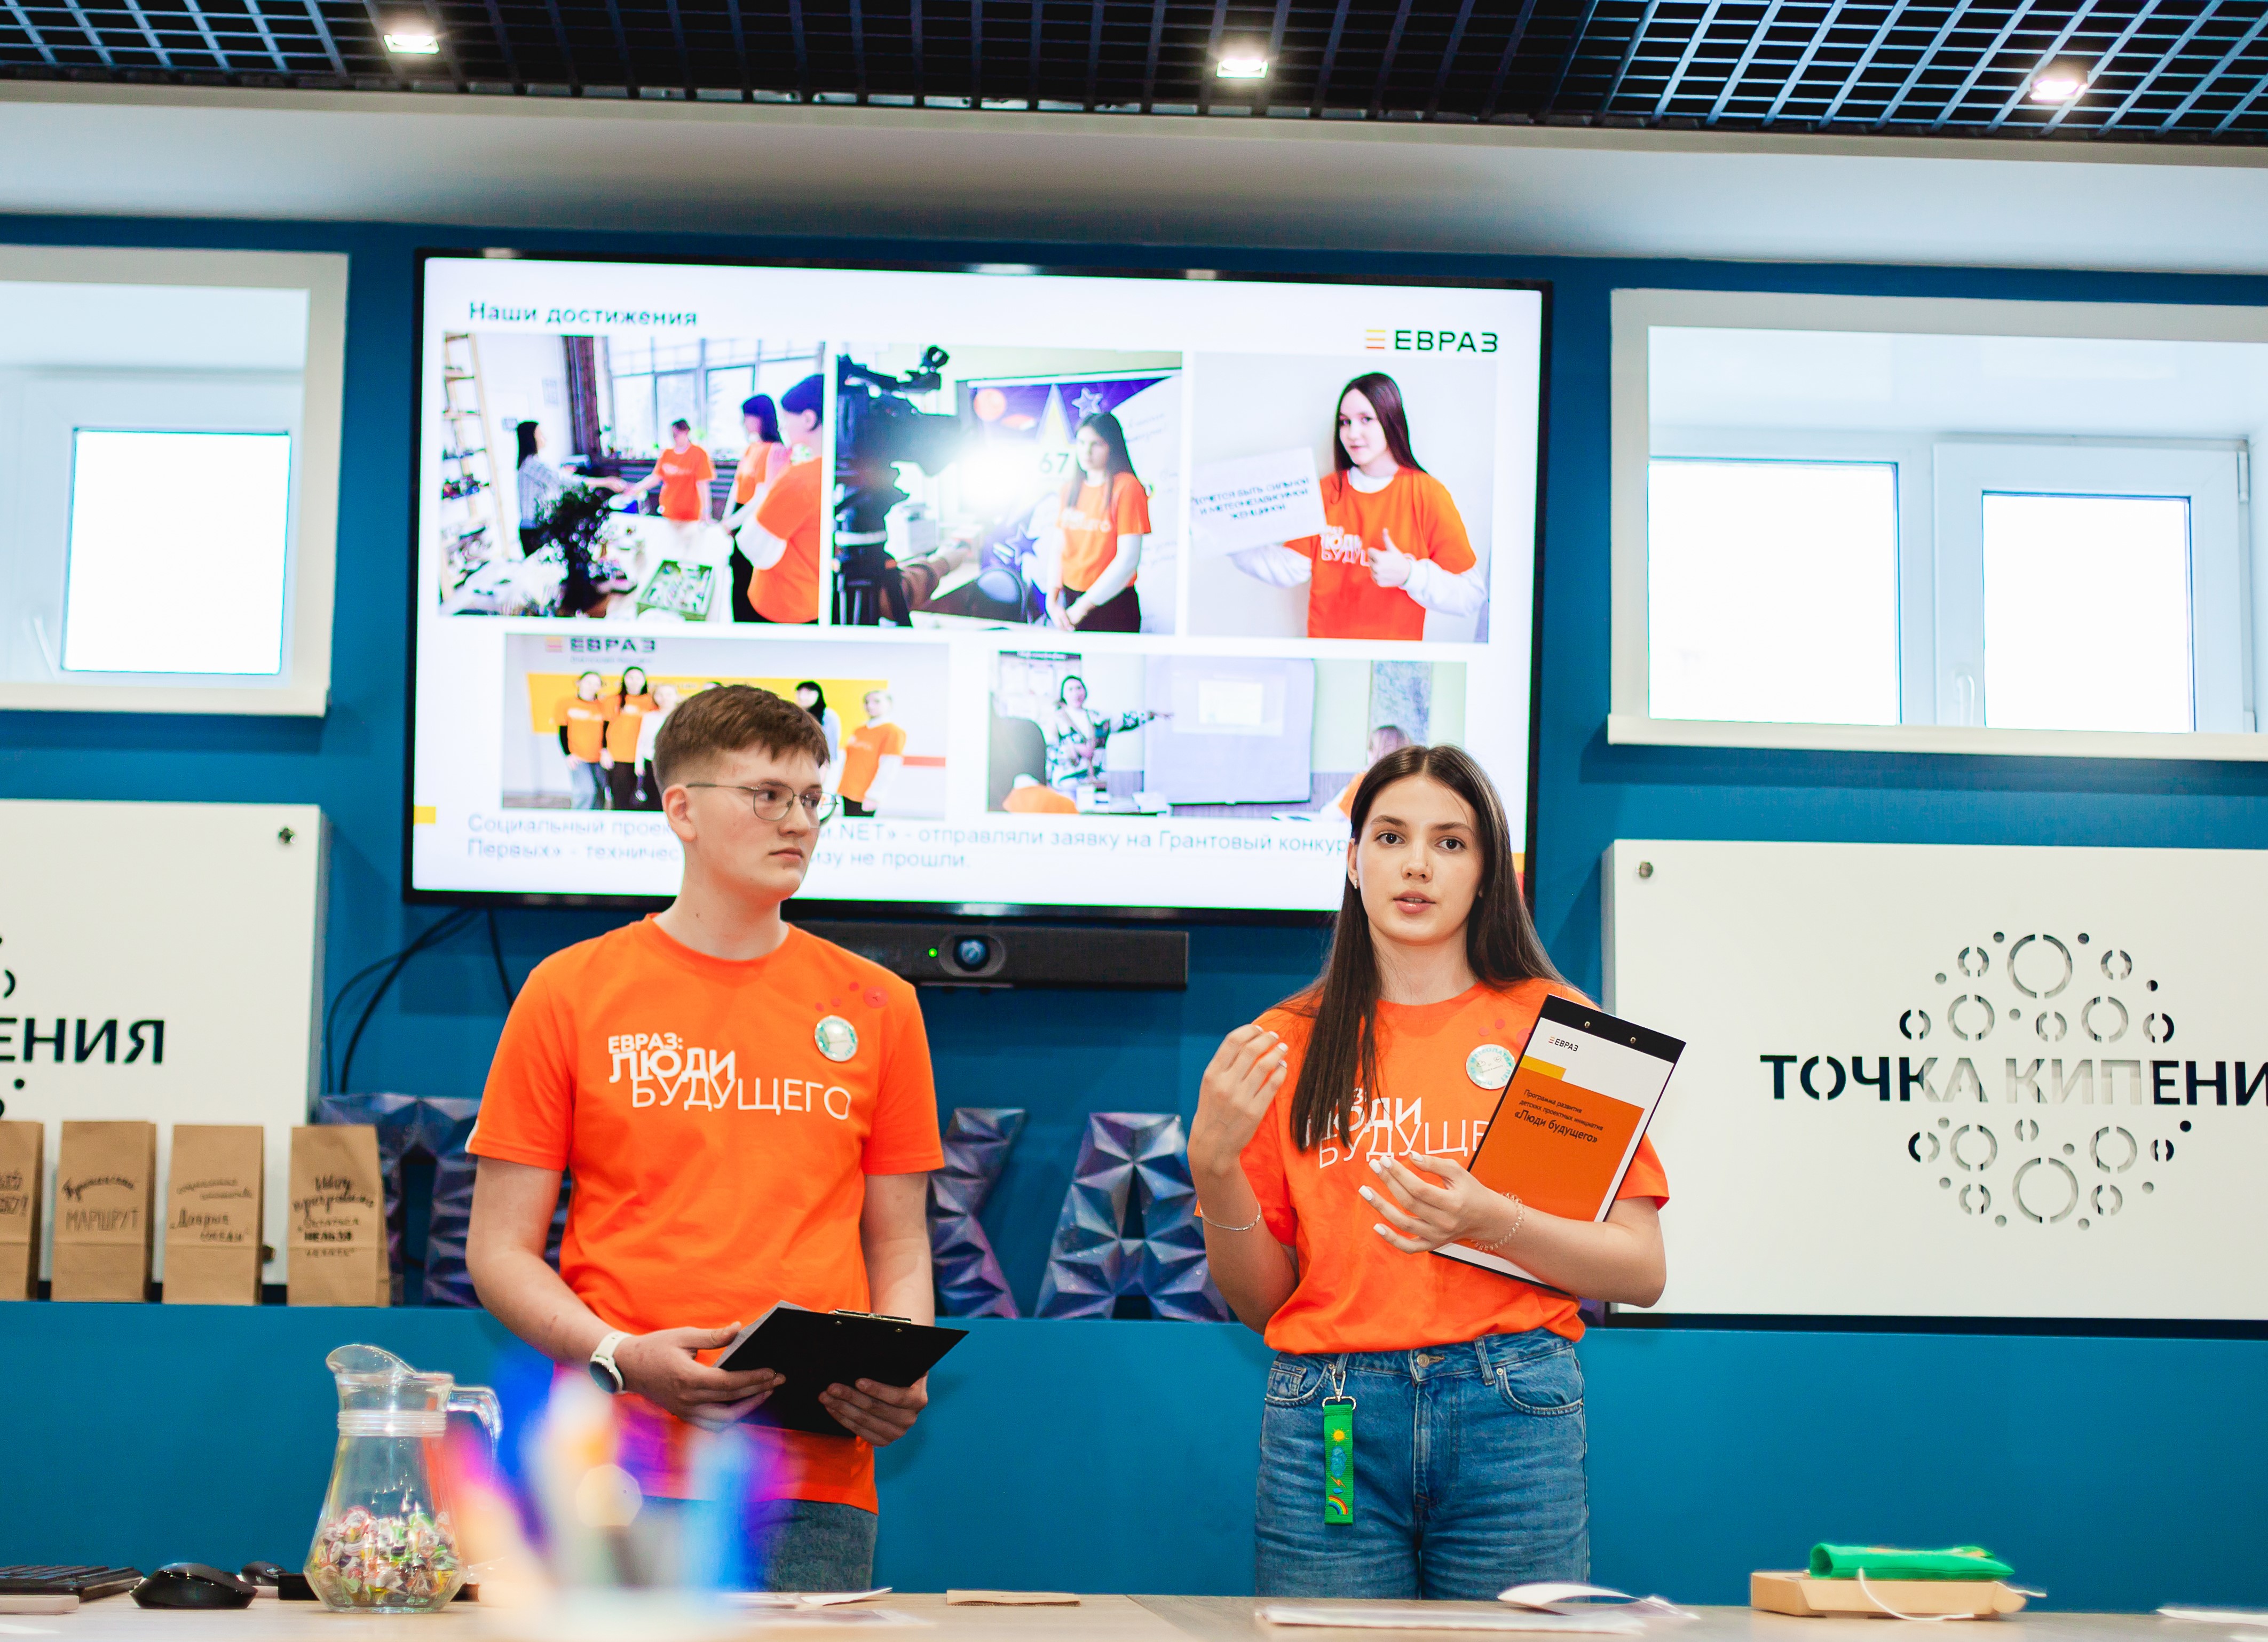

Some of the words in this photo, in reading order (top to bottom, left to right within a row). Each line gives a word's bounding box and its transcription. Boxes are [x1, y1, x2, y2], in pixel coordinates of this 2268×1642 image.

[469, 302, 536, 321] Наши
[546, 307, 698, 327] достижения
[1395, 330, 1498, 352] ЕВРАЗ
[571, 638, 655, 652] ЕВРАЗ
[468, 814, 604, 834] Социальный
[612, 820, 673, 837] проек
[919, 828, 1043, 847] отправляли
[1050, 832, 1120, 851] заявку
[1127, 835, 1151, 847] на
[1159, 830, 1271, 852] Грантовый
[1279, 836, 1347, 856] конкур
[587, 845, 679, 861] техничес
[851, 853, 874, 866] не
[0, 1018, 164, 1063] ЕНИЯ
[608, 1032, 683, 1053] ЕВРАЗ:
[1554, 1038, 1578, 1052] ЕВРАЗ
[609, 1048, 736, 1083] ЛЮДИ
[1760, 1054, 1989, 1103] ТОЧКА
[2005, 1057, 2268, 1107] КИПЕНИ
[632, 1076, 851, 1120] БУДУЩЕГО
[1524, 1089, 1556, 1105] Программа
[1556, 1101, 1583, 1113] развития
[1306, 1097, 1421, 1147] ЮДИ
[1515, 1109, 1547, 1127] «Люди
[1548, 1120, 1598, 1143] будущего»
[1519, 1100, 1542, 1110] детских
[1543, 1107, 1573, 1121] проектных
[1574, 1118, 1603, 1131] инициатив
[1319, 1120, 1490, 1169] БУДУЩЕ
[65, 1207, 138, 1232] МАРШРУТ
